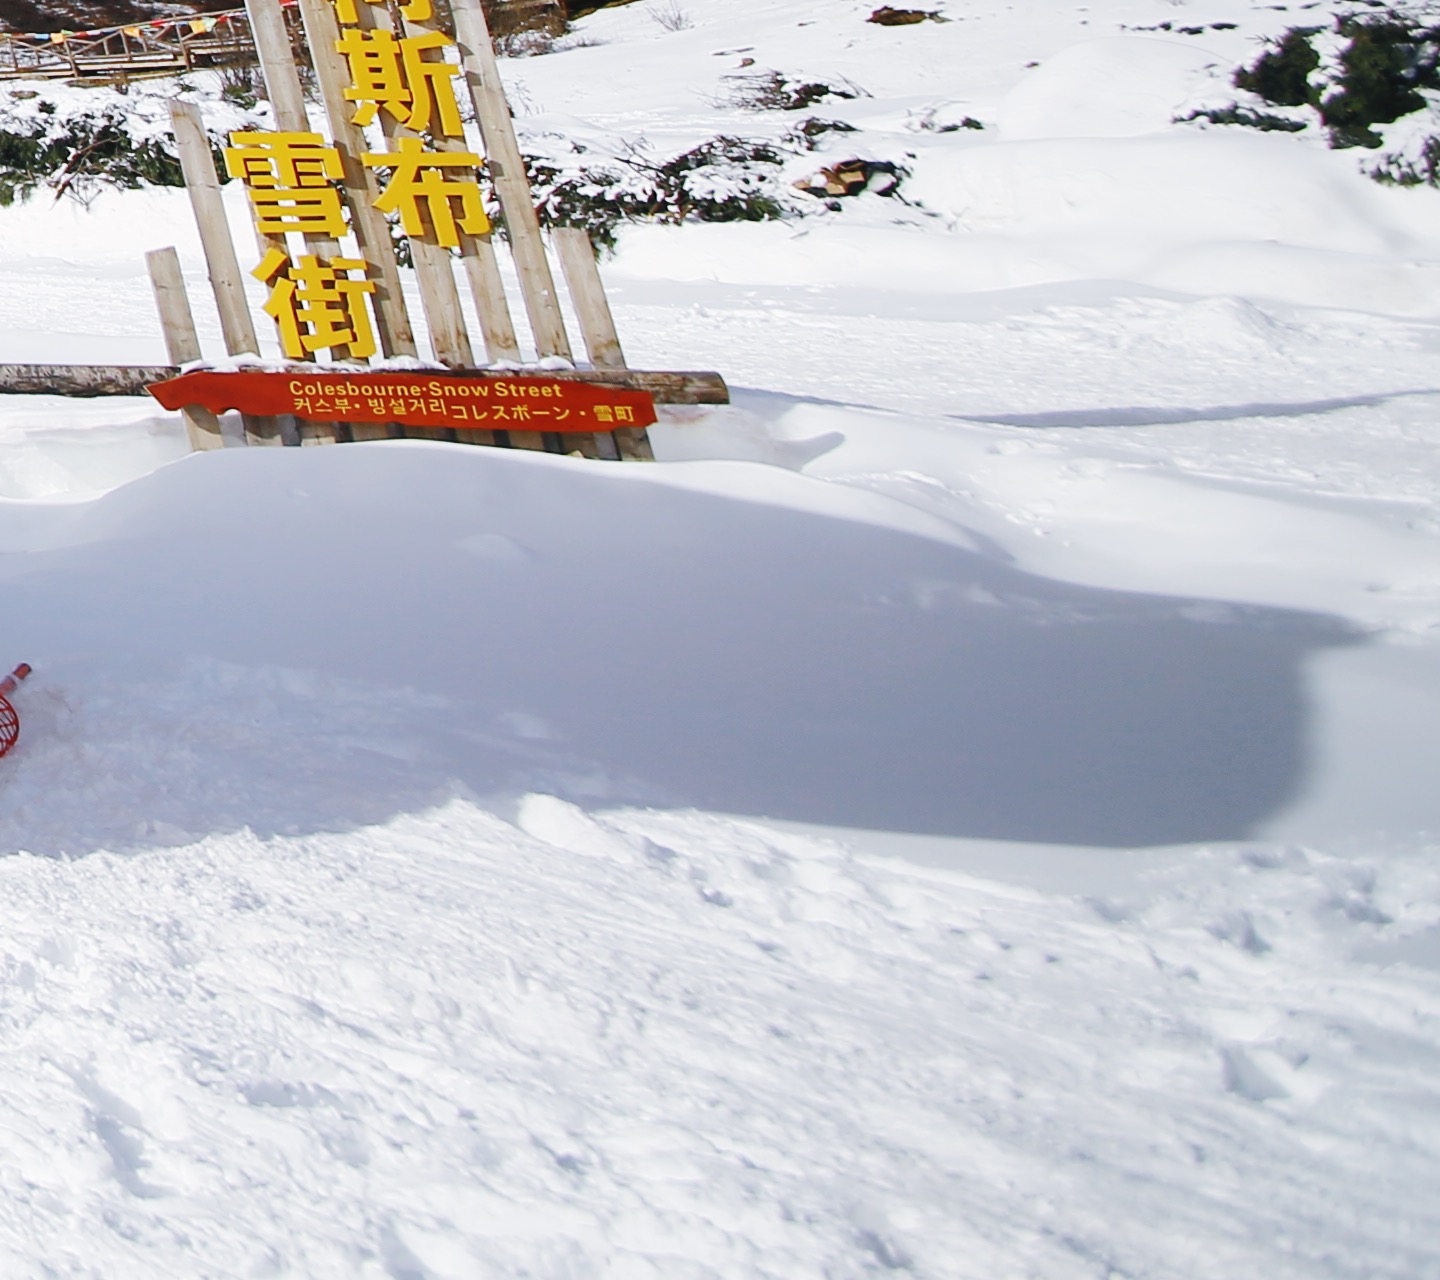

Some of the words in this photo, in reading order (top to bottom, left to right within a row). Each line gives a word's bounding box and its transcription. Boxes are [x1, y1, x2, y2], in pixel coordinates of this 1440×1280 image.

[223, 131, 378, 359] 雪街
[493, 381, 565, 397] Street
[368, 397, 448, 416] 빙설거리
